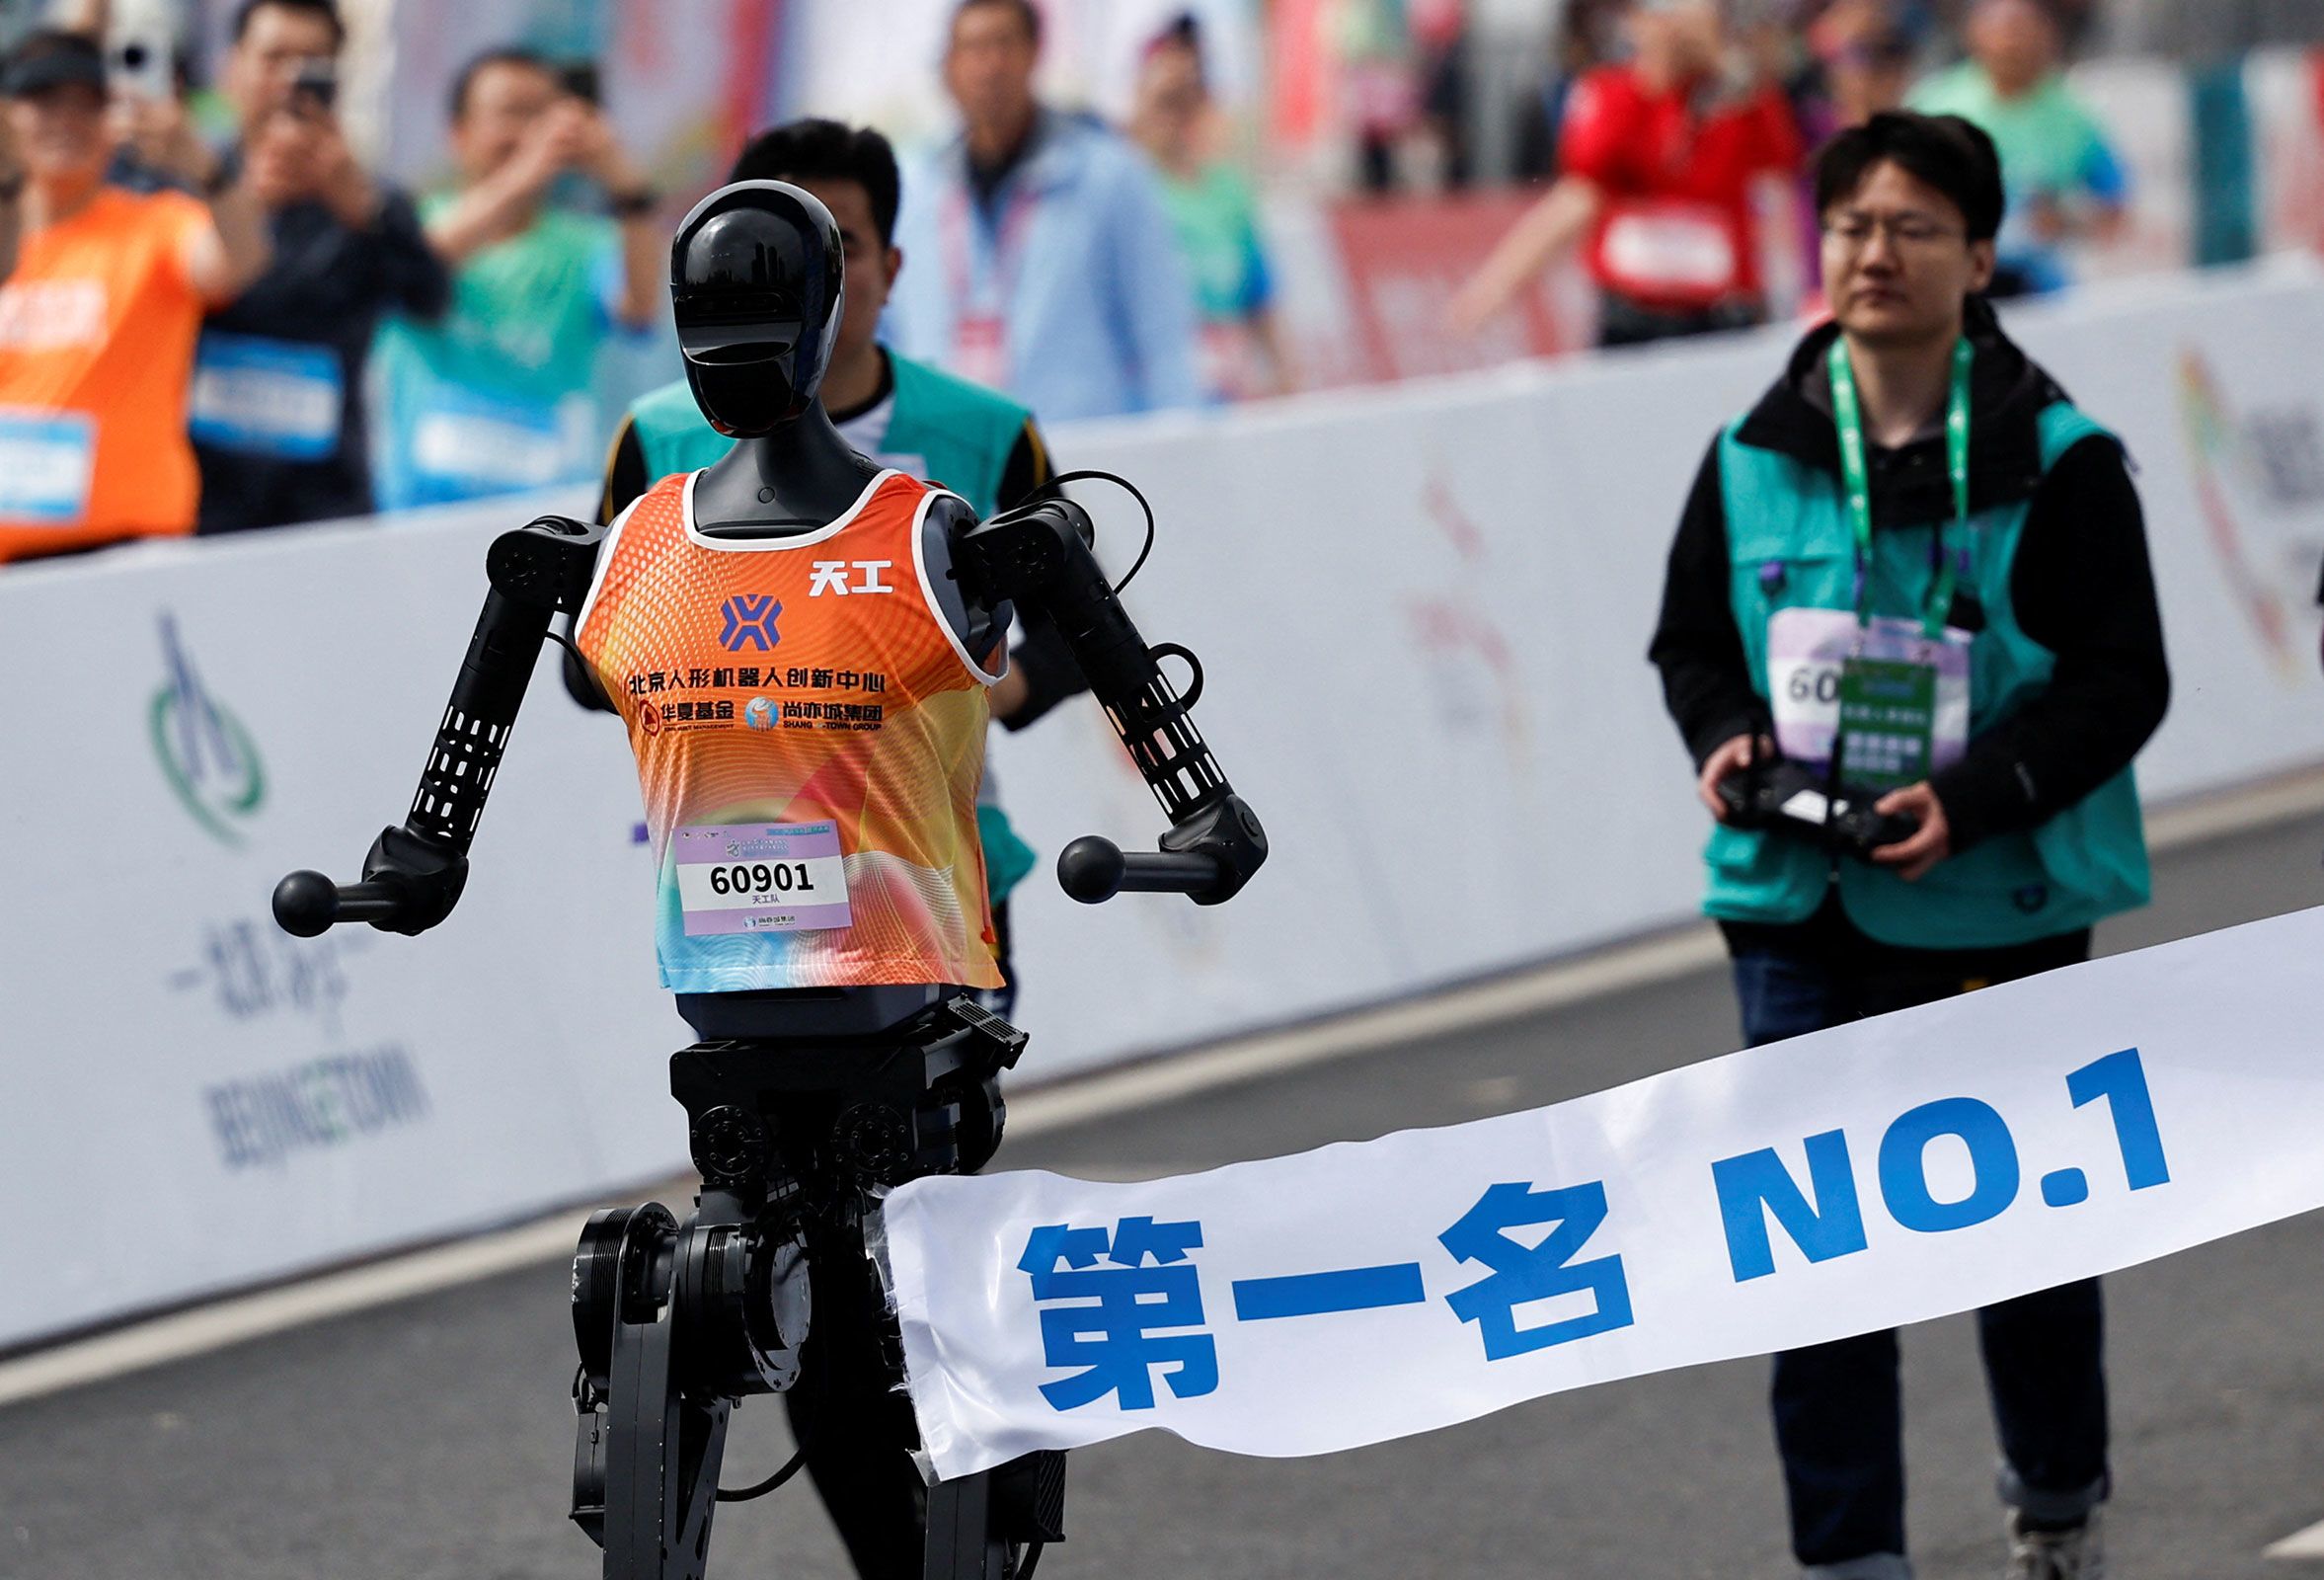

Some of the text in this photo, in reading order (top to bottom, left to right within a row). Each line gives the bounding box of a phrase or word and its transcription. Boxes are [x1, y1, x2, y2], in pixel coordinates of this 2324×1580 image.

[809, 560, 893, 596] 天工
[629, 667, 886, 693] 北京人形机器人创新中心
[660, 700, 735, 722] 华夏基金
[783, 701, 883, 722] 尚亦城集团
[710, 863, 814, 895] 60901
[752, 894, 780, 905] 天工队
[1016, 1047, 2170, 1411] 第一名 NO.1
